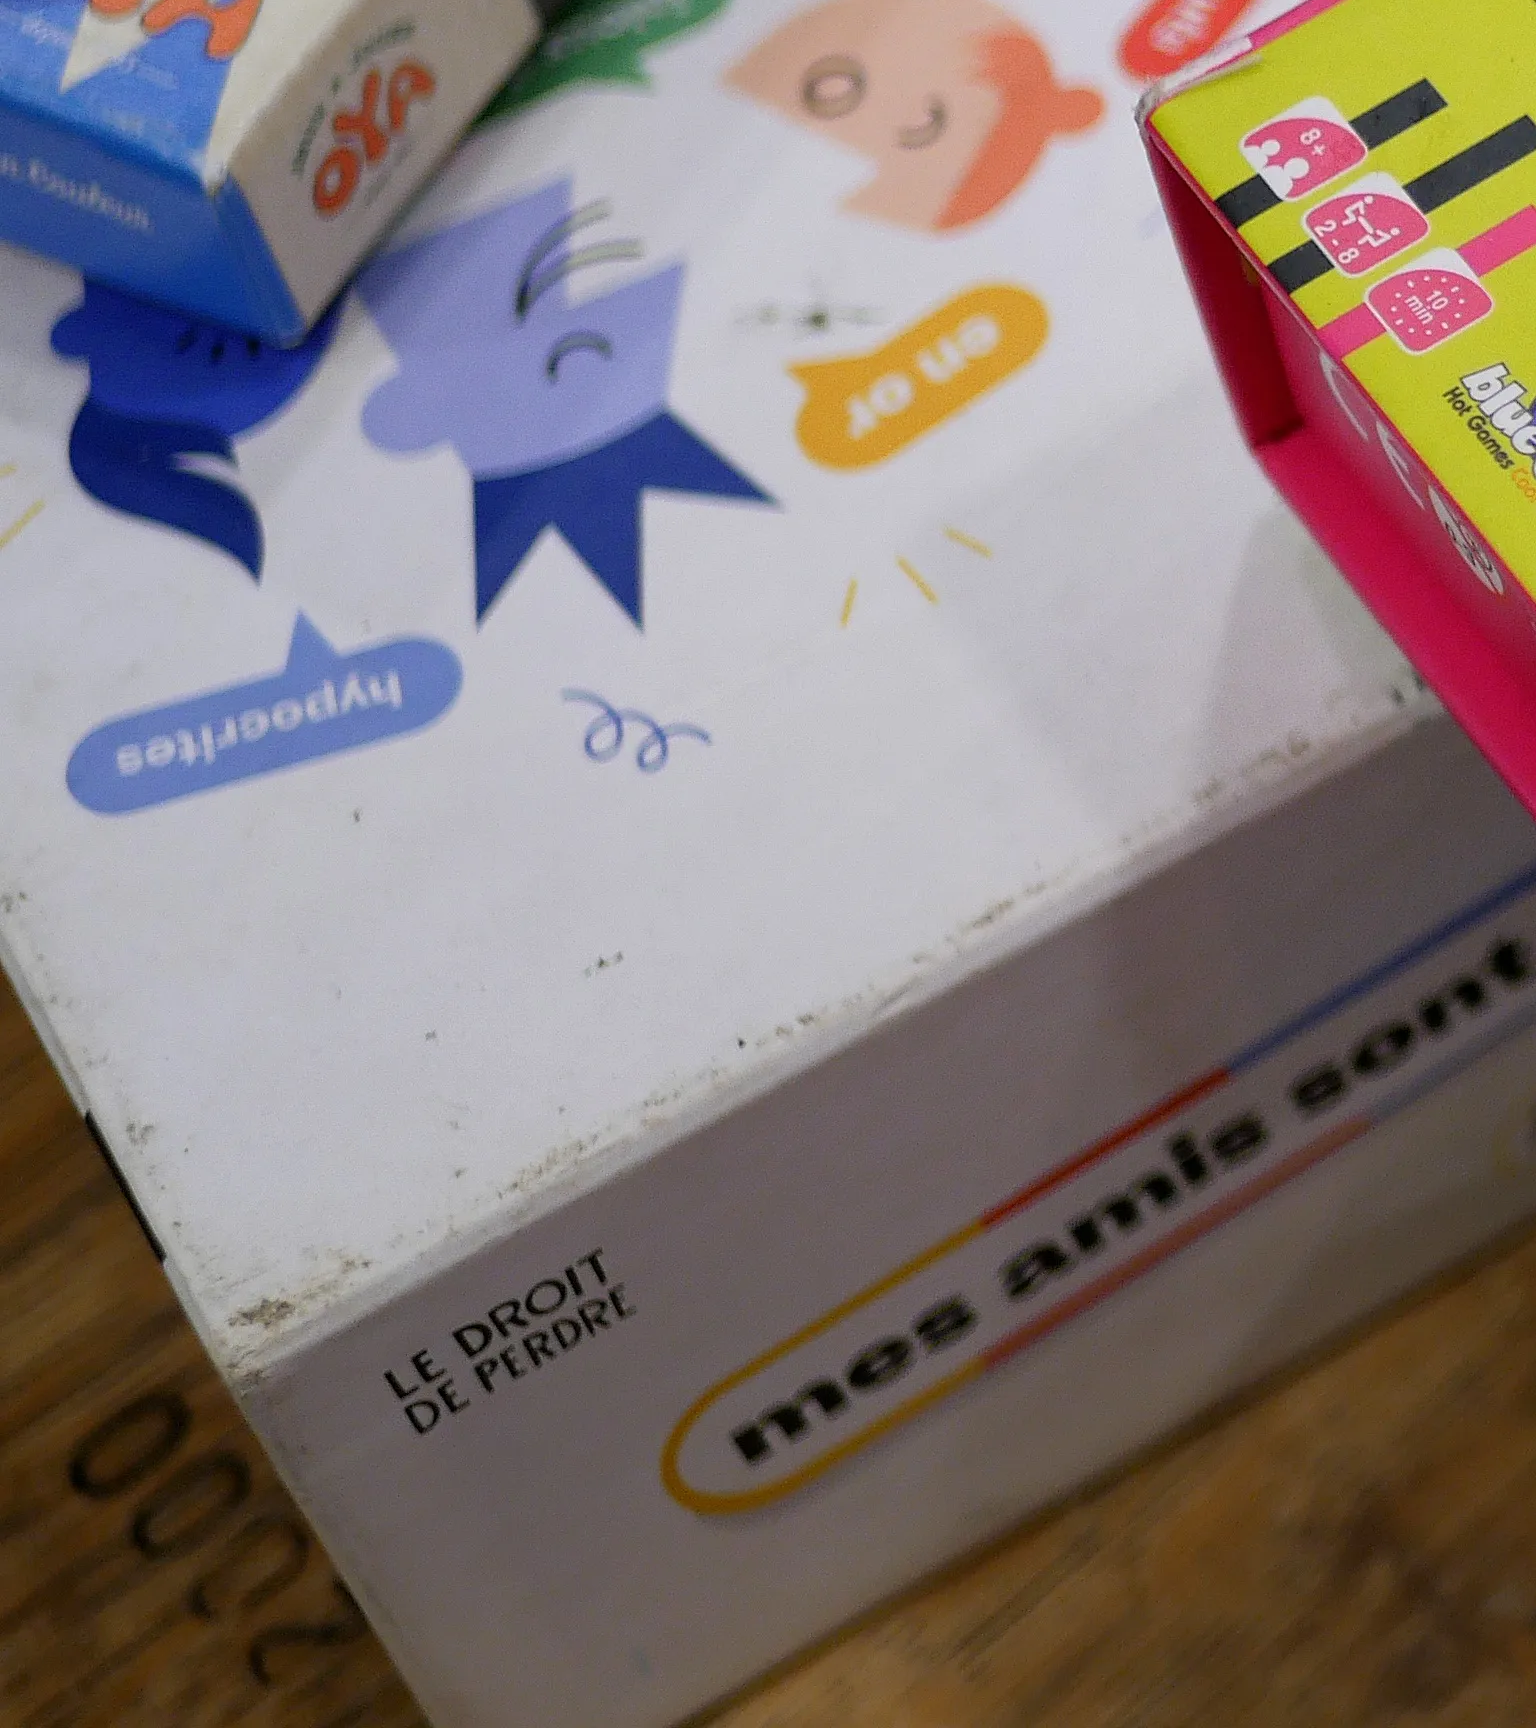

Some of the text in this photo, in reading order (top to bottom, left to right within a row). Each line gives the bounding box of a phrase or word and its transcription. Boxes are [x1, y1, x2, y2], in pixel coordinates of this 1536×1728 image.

[312, 61, 435, 216] OYA
[1300, 127, 1327, 158] 8+
[1404, 292, 1435, 326] min
[1425, 289, 1449, 312] 10
[846, 313, 1001, 439] en or
[1443, 385, 1469, 417] Hot
[1466, 418, 1515, 471] Games
[112, 669, 402, 776] hypocrites
[383, 1248, 612, 1400] LE DROIT
[728, 1295, 978, 1466] mes
[998, 1109, 1270, 1300] amis
[403, 1283, 638, 1435] DE PERDRE
